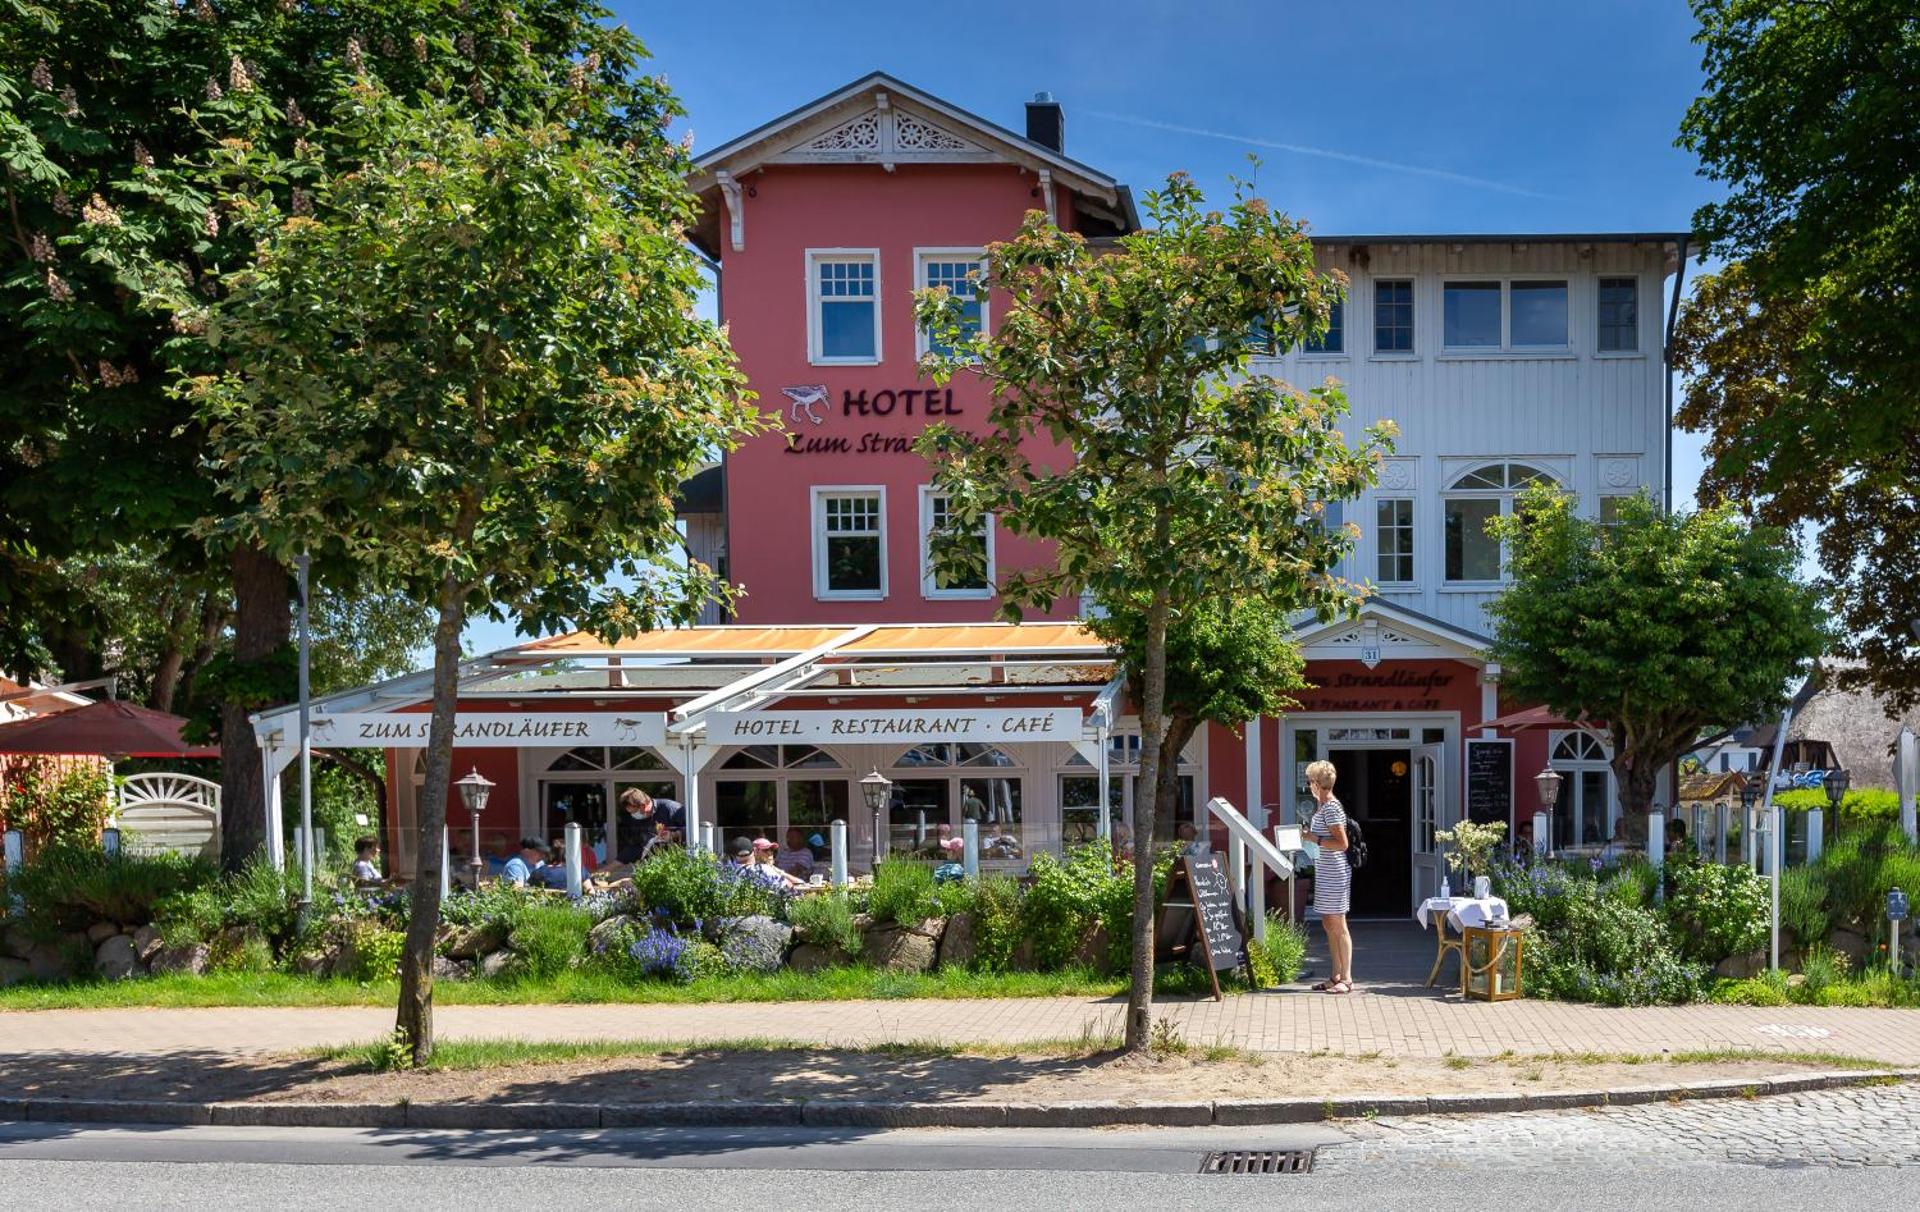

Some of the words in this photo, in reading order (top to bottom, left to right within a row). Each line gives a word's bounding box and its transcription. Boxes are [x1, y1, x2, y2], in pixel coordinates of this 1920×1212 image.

[842, 388, 963, 417] HOTEL
[784, 433, 851, 455] Zum
[1364, 651, 1377, 660] 31
[1334, 669, 1454, 697] Strandläufer
[359, 721, 412, 739] ZUM
[417, 718, 590, 739] SANDLÄUFER
[734, 719, 804, 736] HOTEL
[831, 717, 977, 735] RESTAURANT
[1001, 712, 1055, 734] CAFÉ
